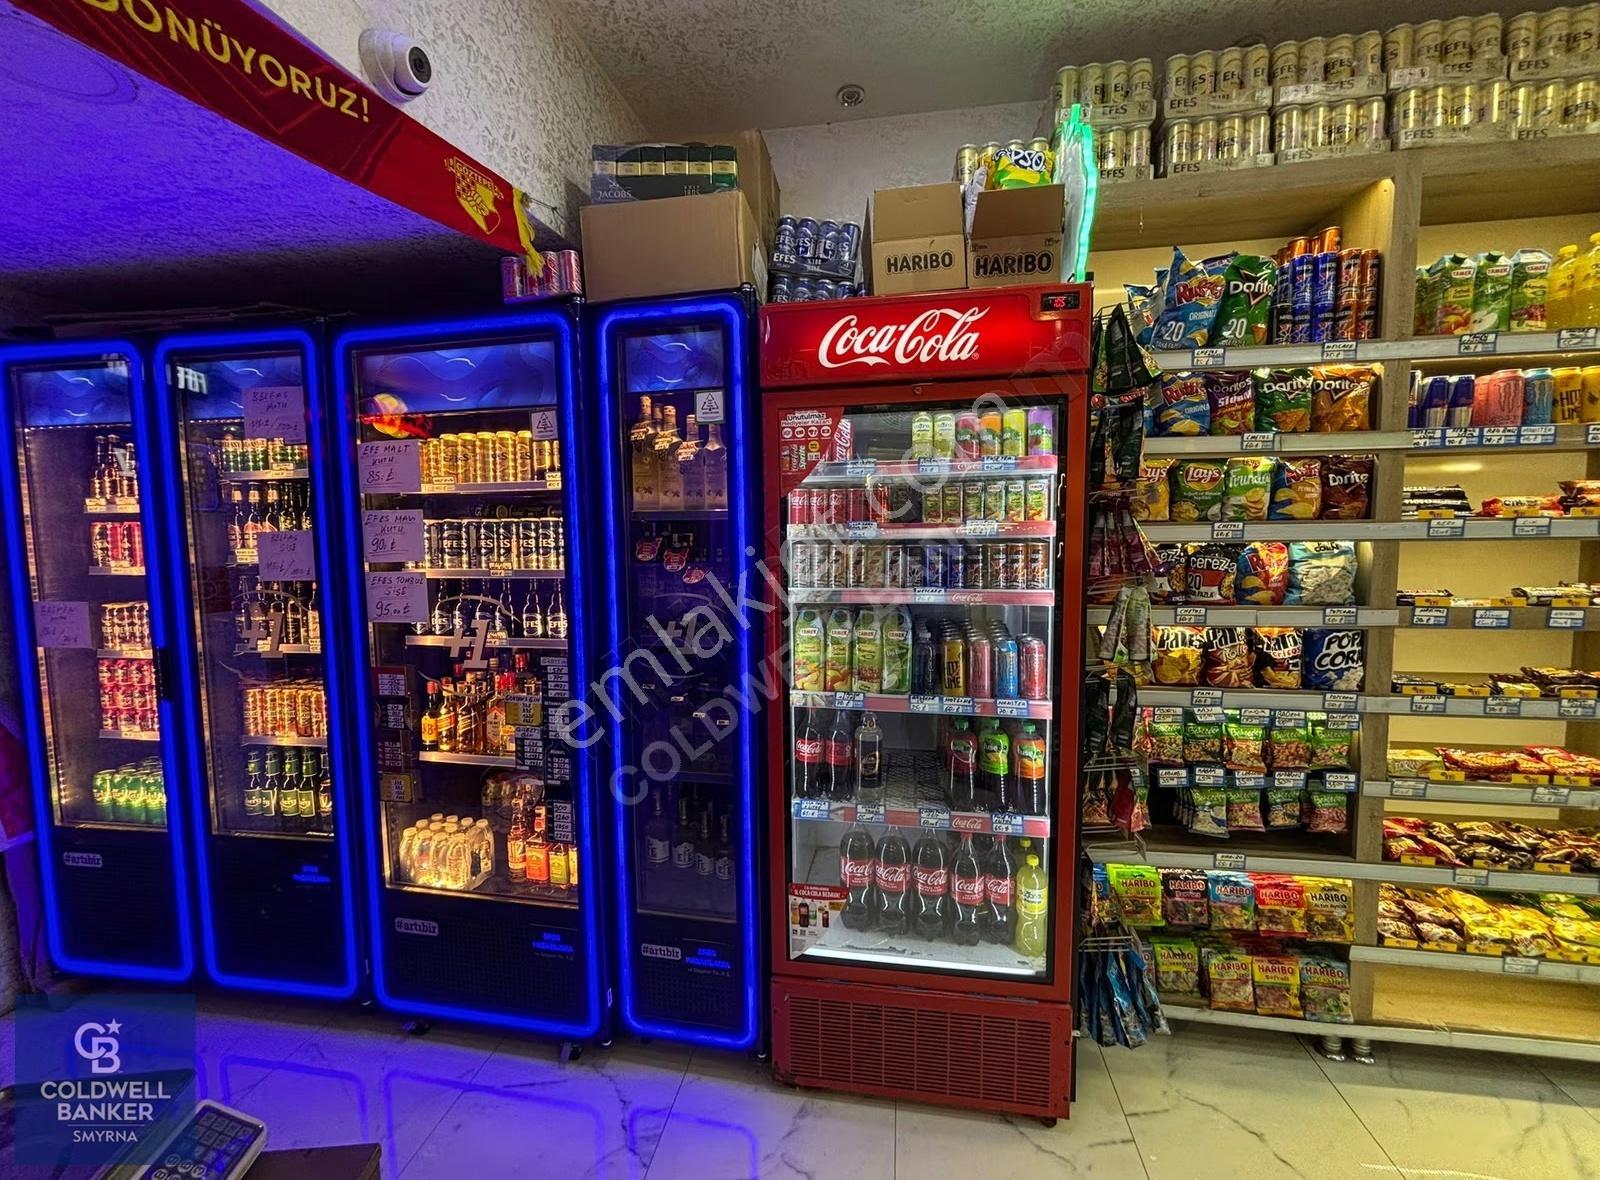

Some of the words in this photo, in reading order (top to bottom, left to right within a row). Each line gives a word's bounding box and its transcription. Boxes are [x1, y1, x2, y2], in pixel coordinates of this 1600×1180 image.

[773, 253, 796, 265] EFES
[886, 251, 954, 274] HARIBO
[974, 252, 1053, 277] HARIBO
[817, 306, 991, 369] Coca-Cola
[1121, 879, 1156, 889] HARIBO
[1168, 880, 1206, 891] HARIBO
[1216, 886, 1251, 896] HARIBO
[1260, 889, 1300, 900] HARIBO
[1310, 892, 1348, 903] HARIBO
[1213, 961, 1248, 971] HARIBO
[1257, 964, 1294, 975] HARIBO
[1305, 967, 1345, 978] HARIBO
